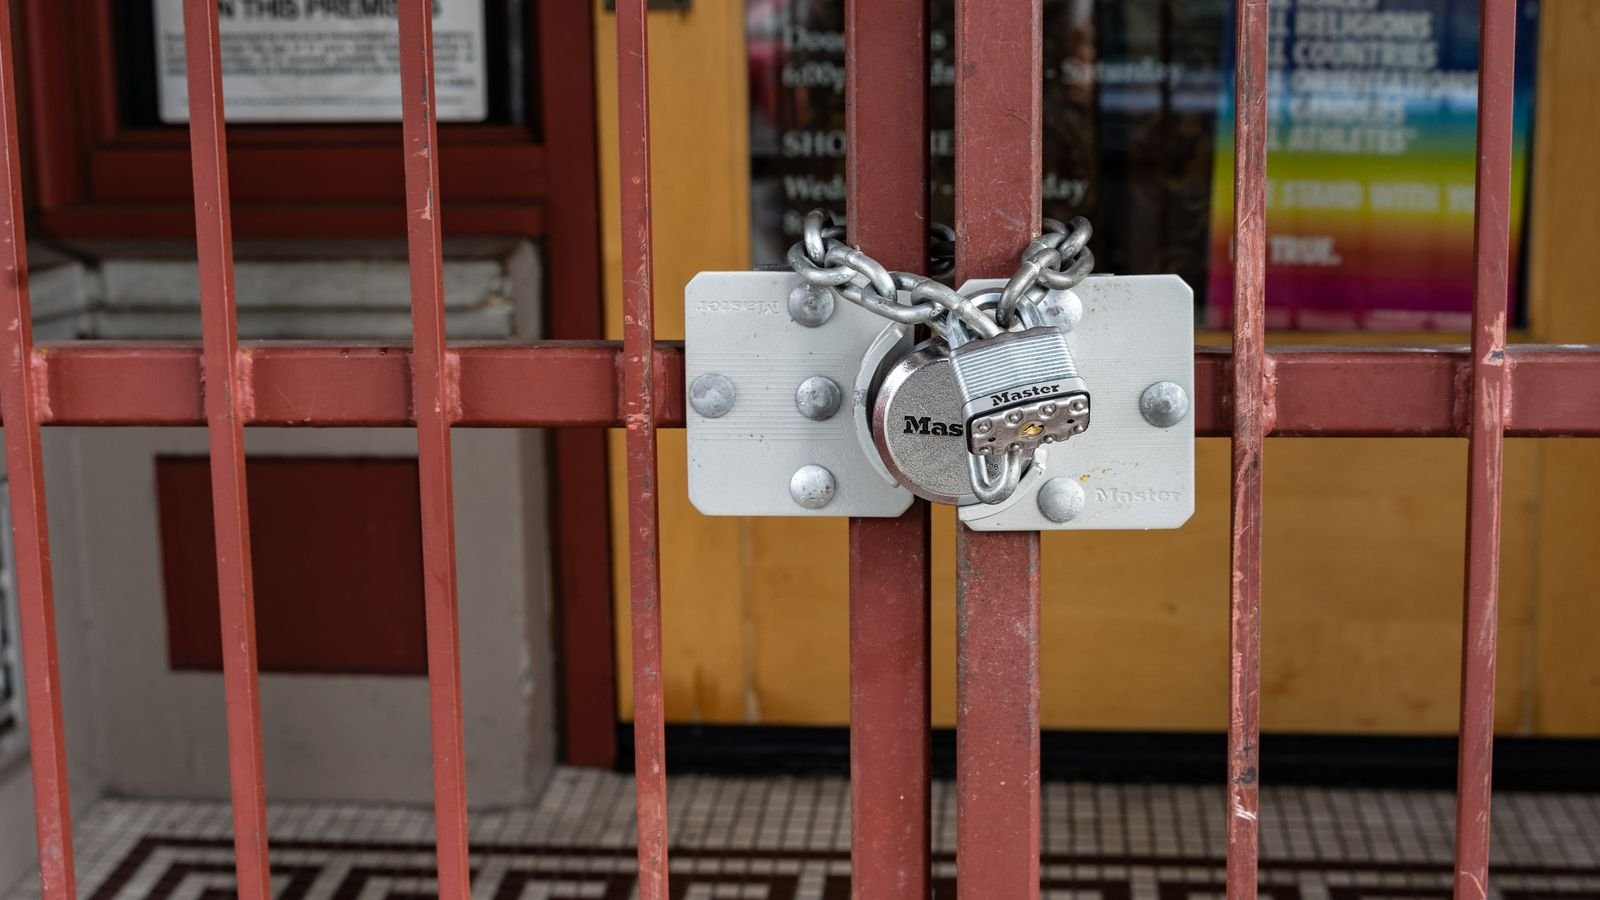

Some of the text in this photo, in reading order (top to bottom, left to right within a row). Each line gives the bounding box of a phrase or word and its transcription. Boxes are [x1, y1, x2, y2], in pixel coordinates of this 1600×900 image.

[990, 384, 1060, 406] Master
[903, 416, 963, 437] Mas
[1095, 487, 1183, 503] Master
